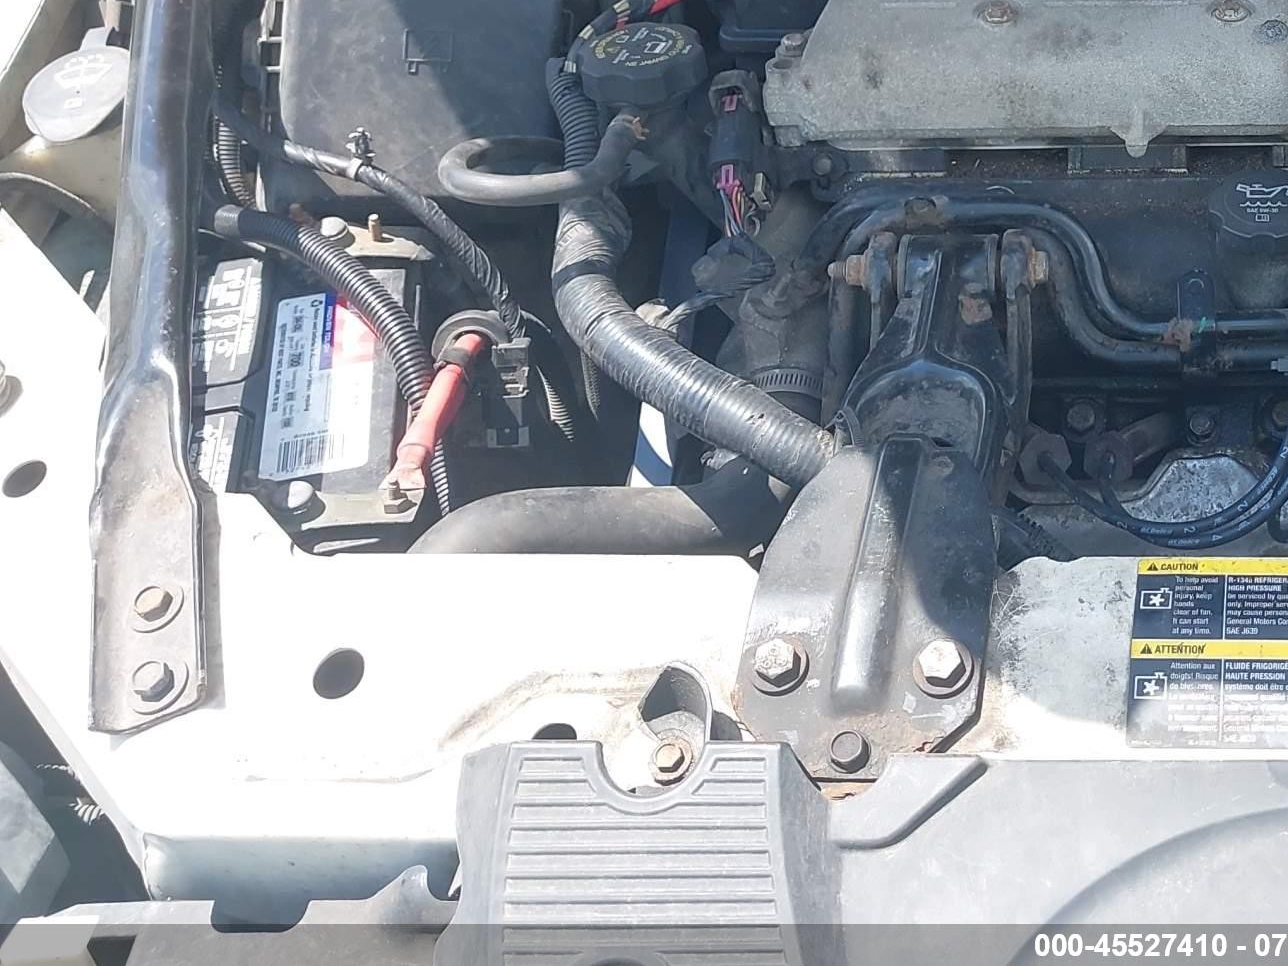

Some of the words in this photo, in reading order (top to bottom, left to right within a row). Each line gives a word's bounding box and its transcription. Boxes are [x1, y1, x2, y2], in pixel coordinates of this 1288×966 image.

[1280, 446, 1288, 458] 2
[1186, 576, 1199, 584] help
[1175, 592, 1195, 600] injury,
[1196, 592, 1212, 600] keep
[1172, 627, 1178, 635] at
[1195, 627, 1211, 635] time.
[1226, 627, 1240, 635] SAE
[1242, 627, 1258, 635] J639
[1155, 644, 1205, 654] ATTENTION
[1225, 672, 1248, 680] HAUTE
[1250, 673, 1285, 681] PRESSION
[1255, 683, 1268, 691] doit
[1270, 683, 1283, 691] être
